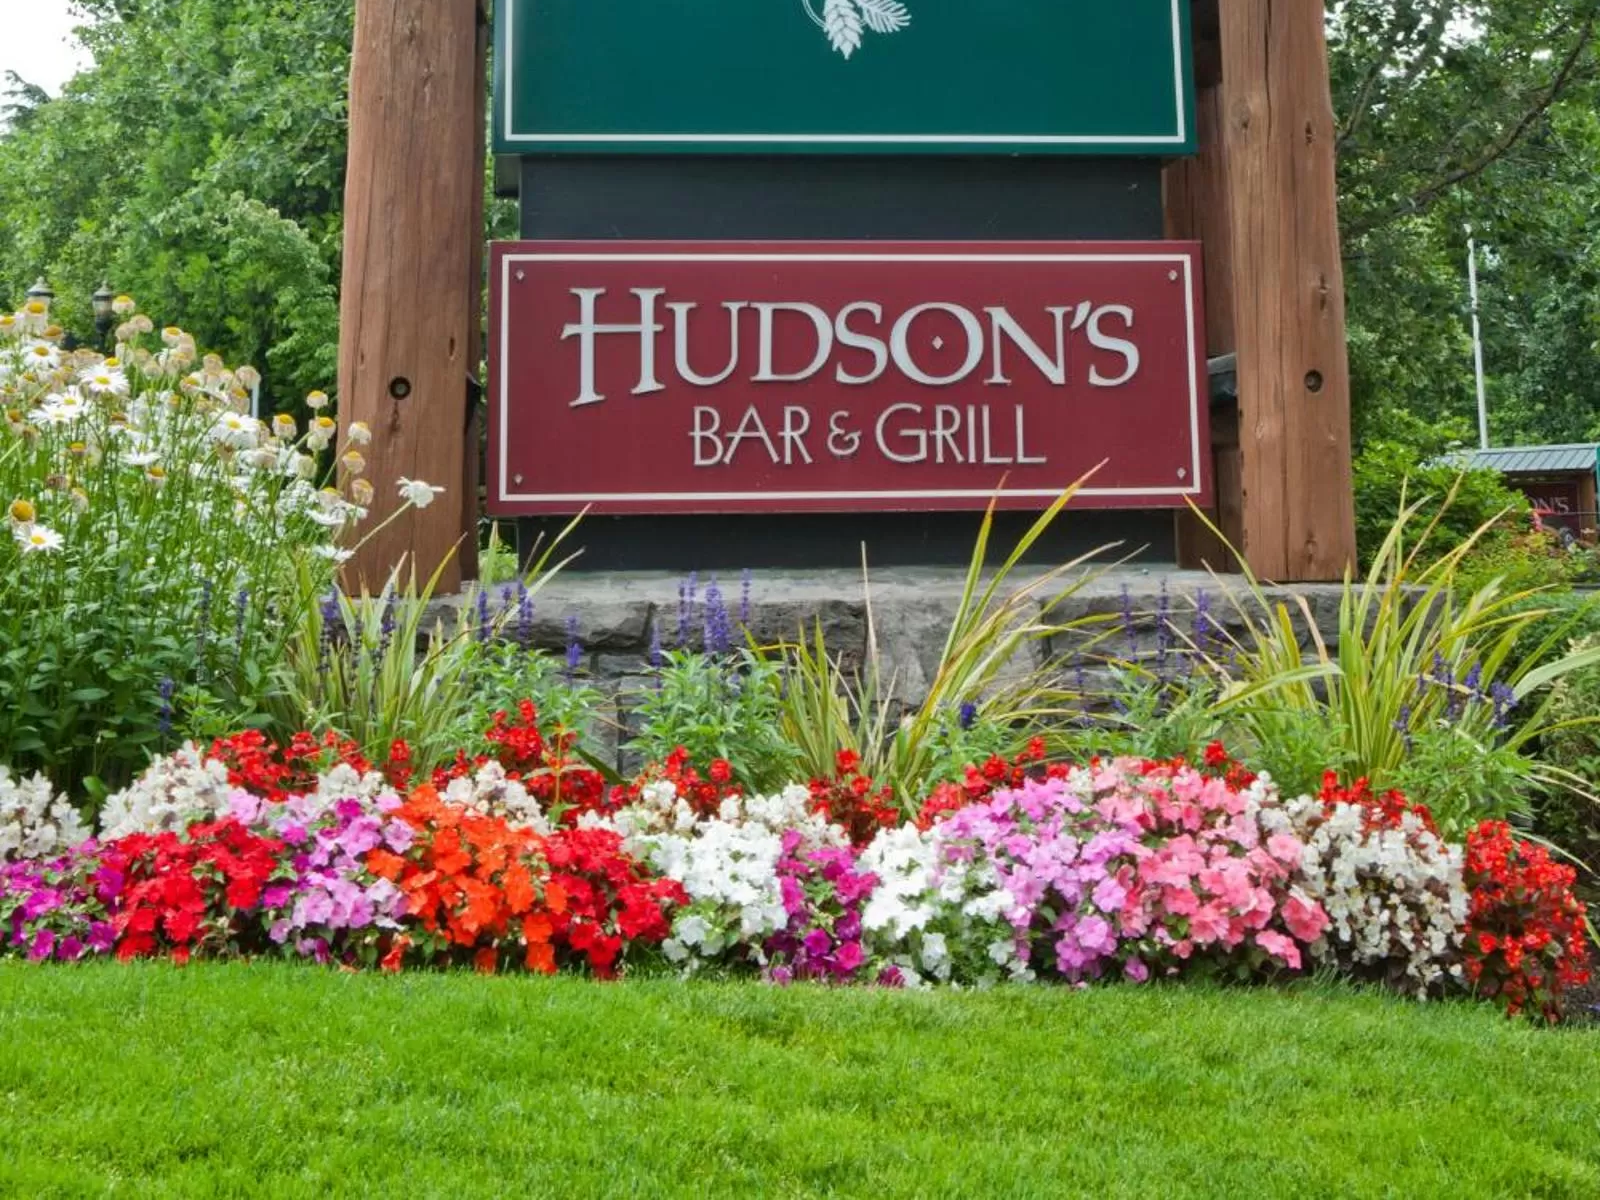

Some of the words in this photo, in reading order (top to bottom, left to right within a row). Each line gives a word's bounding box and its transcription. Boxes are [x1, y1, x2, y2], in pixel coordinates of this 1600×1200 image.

[561, 287, 1140, 408] HUDSON'S
[688, 405, 813, 467] BAR
[827, 410, 861, 456] &
[876, 403, 1047, 465] GRILL
